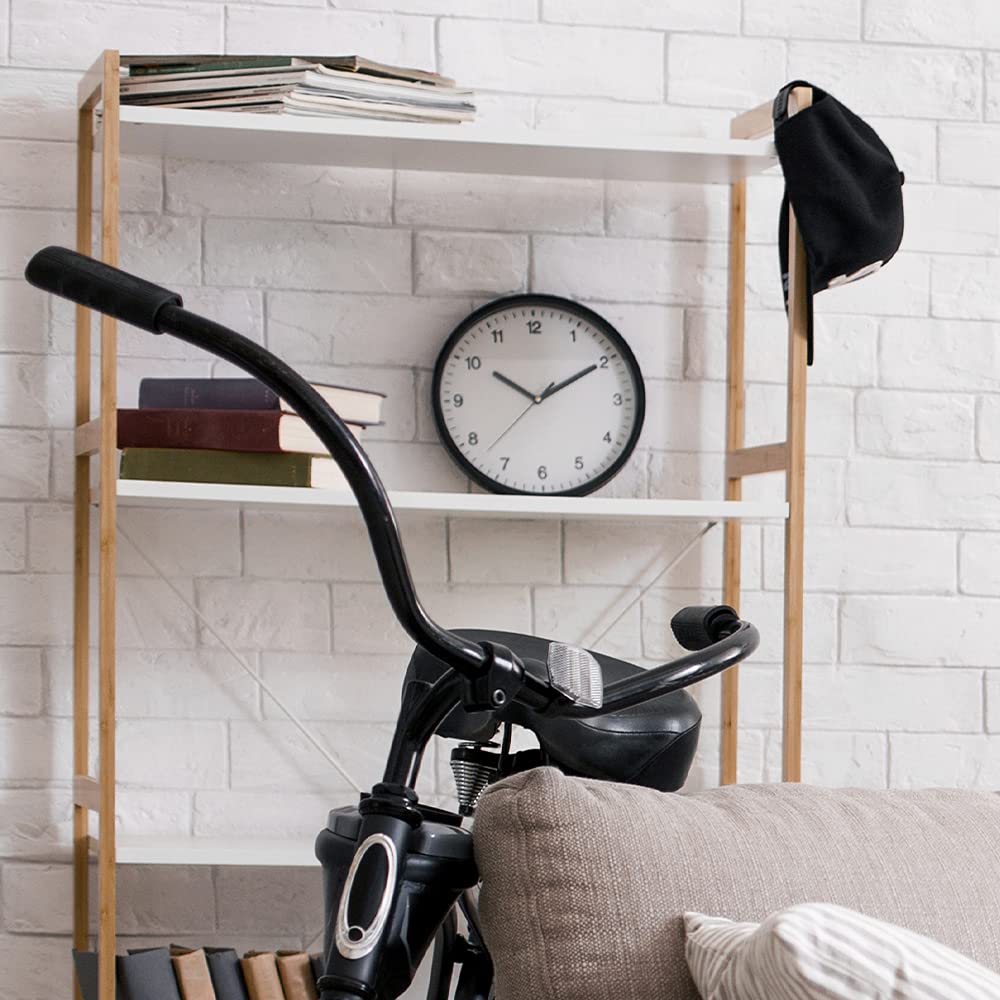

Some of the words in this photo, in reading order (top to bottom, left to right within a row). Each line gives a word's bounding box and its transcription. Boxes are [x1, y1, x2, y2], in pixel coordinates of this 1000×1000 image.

[527, 321, 542, 334] 12
[491, 330, 503, 343] 11
[570, 330, 576, 342] 1
[465, 357, 482, 370] 10
[599, 357, 608, 369] 2
[453, 394, 463, 407] 9
[613, 394, 623, 405] 3
[468, 432, 478, 445] 8
[603, 432, 612, 443] 4
[500, 457, 509, 470] 7
[574, 457, 584, 469] 5
[538, 466, 547, 479] 6
